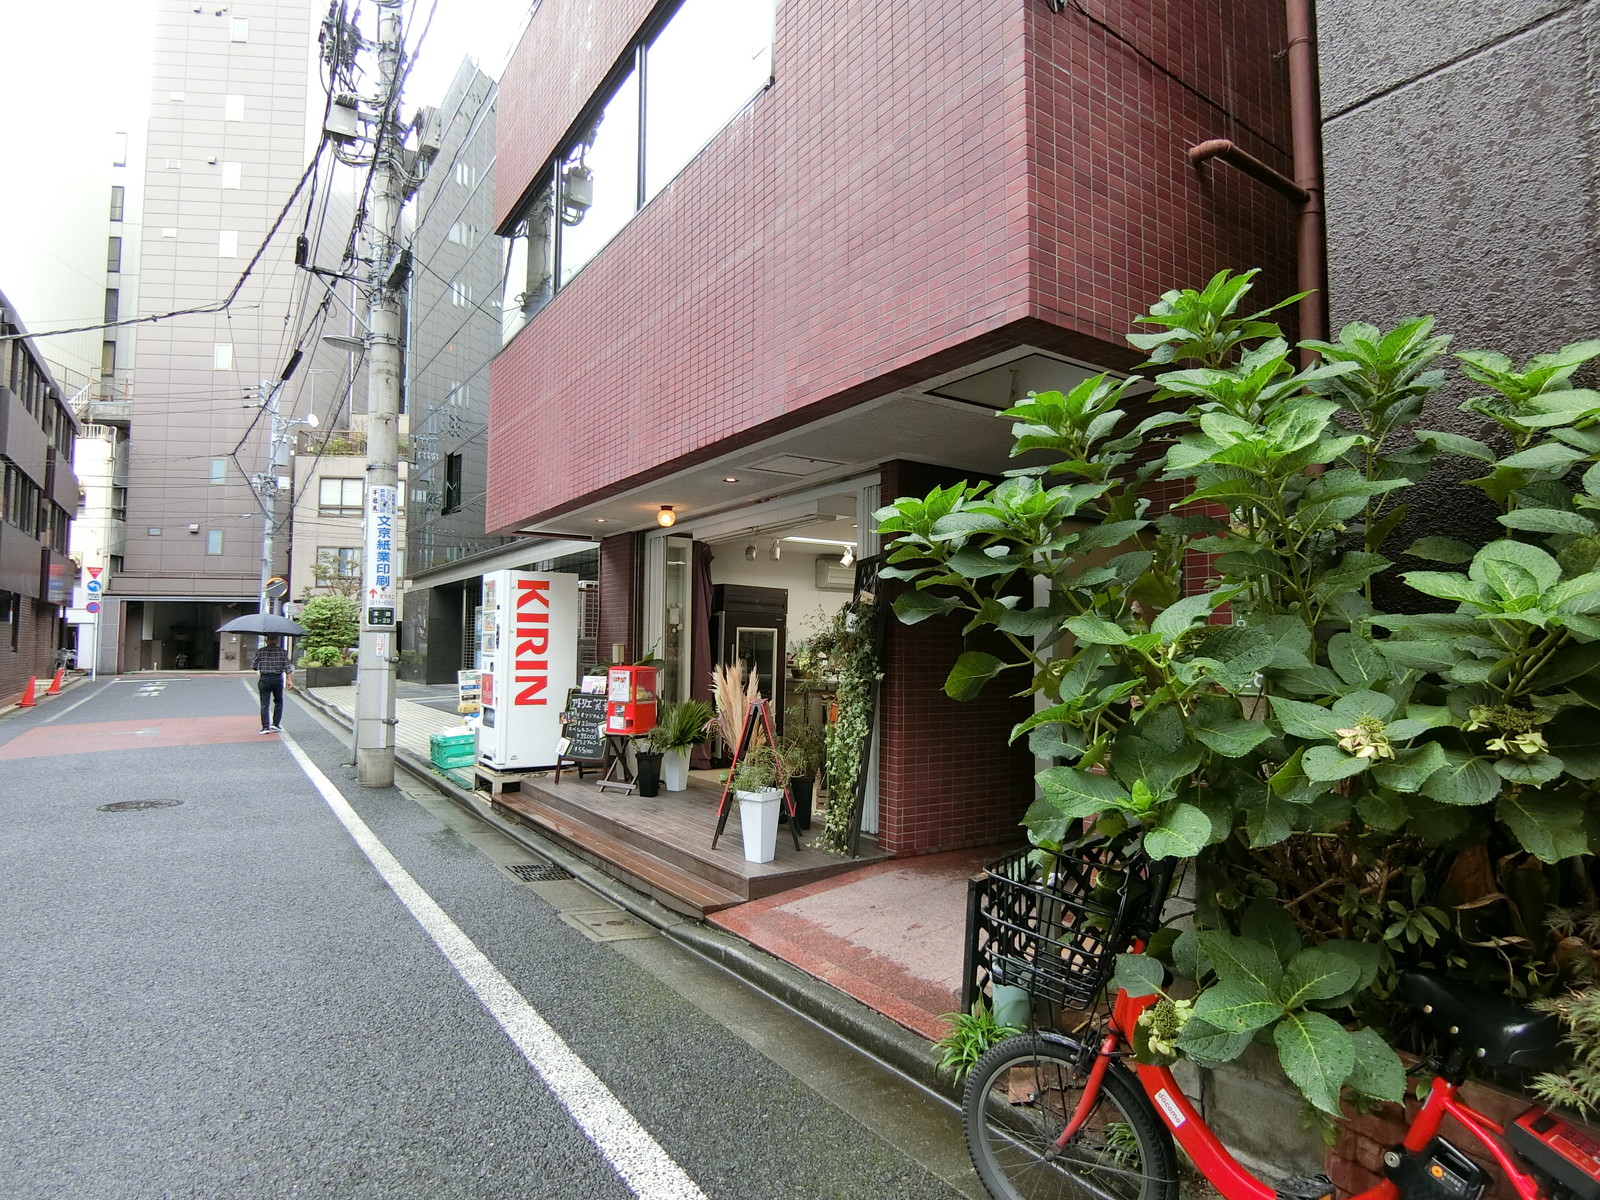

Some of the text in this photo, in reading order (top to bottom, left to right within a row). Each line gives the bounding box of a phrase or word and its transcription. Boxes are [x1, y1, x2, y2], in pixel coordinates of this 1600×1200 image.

[376, 515, 392, 587] 文京紙業印刷
[514, 579, 550, 706] KIRIN
[1158, 1092, 1181, 1124] docomo
